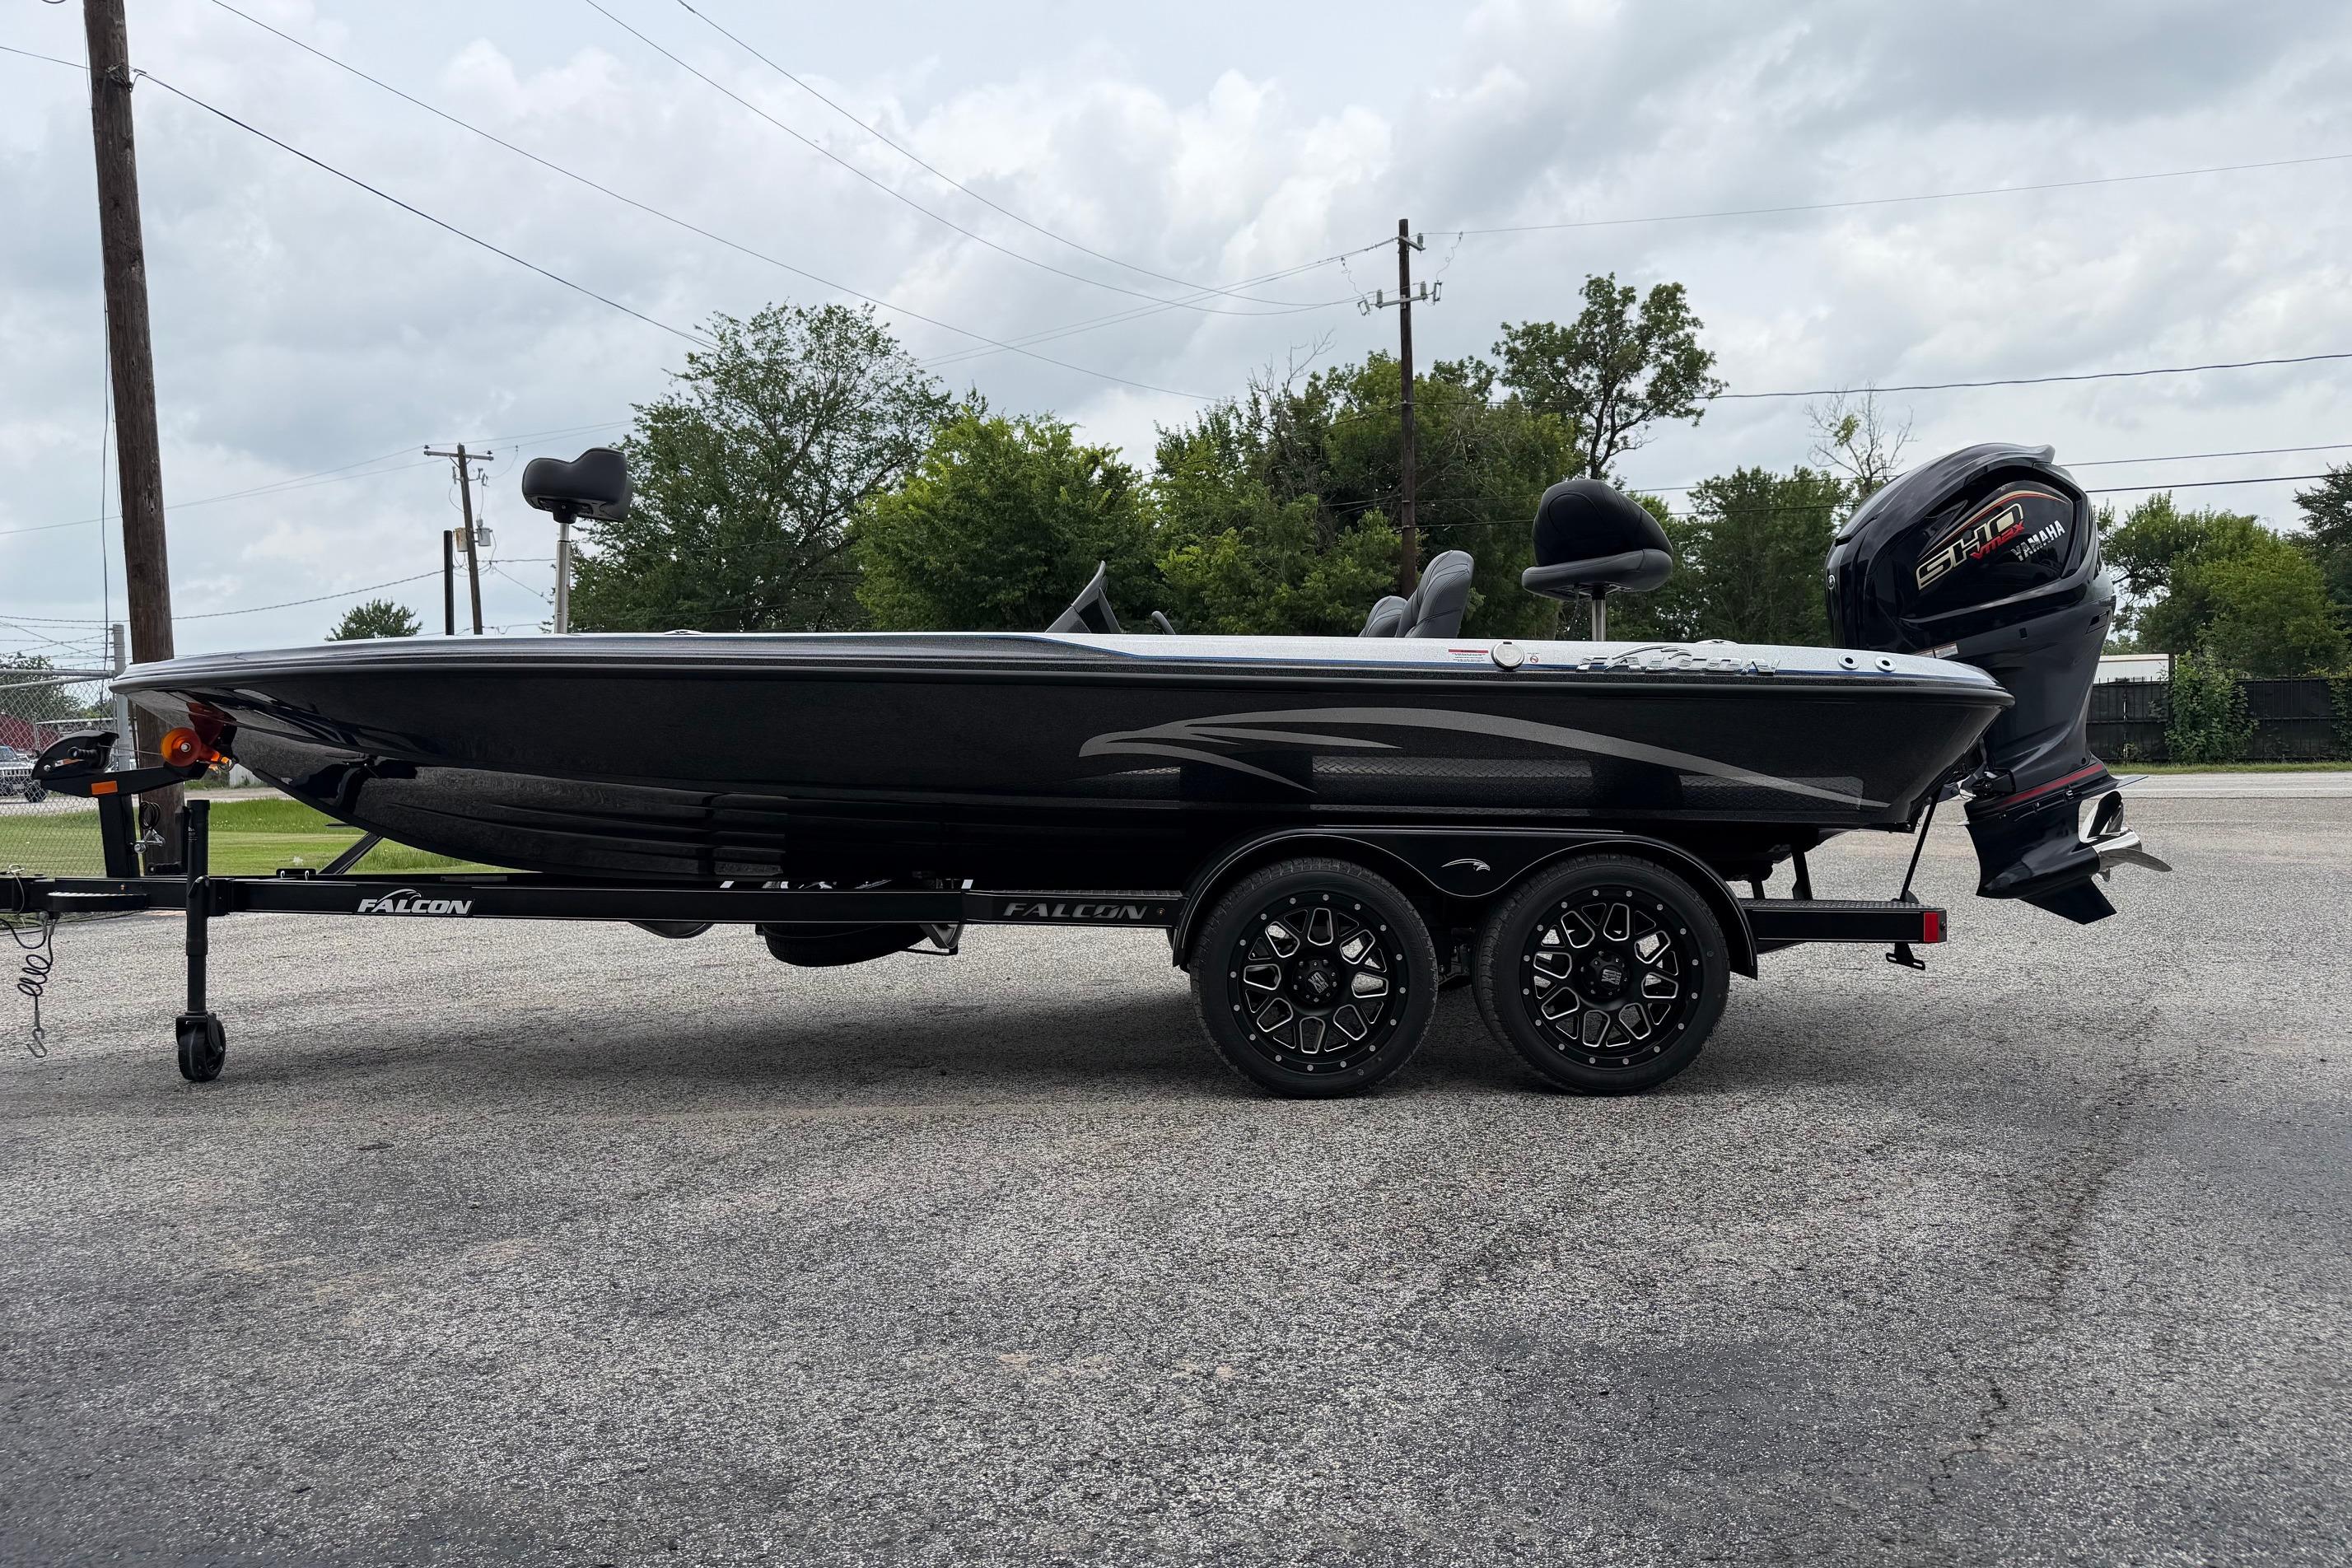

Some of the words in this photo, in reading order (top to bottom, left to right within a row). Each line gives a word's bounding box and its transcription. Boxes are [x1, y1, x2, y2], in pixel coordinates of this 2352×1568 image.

[1916, 502, 2024, 590] SHO
[2010, 520, 2065, 562] YAMAHA
[1575, 654, 1780, 675] FALCON
[357, 898, 473, 915] FALCON
[1002, 903, 1148, 920] FALCON
